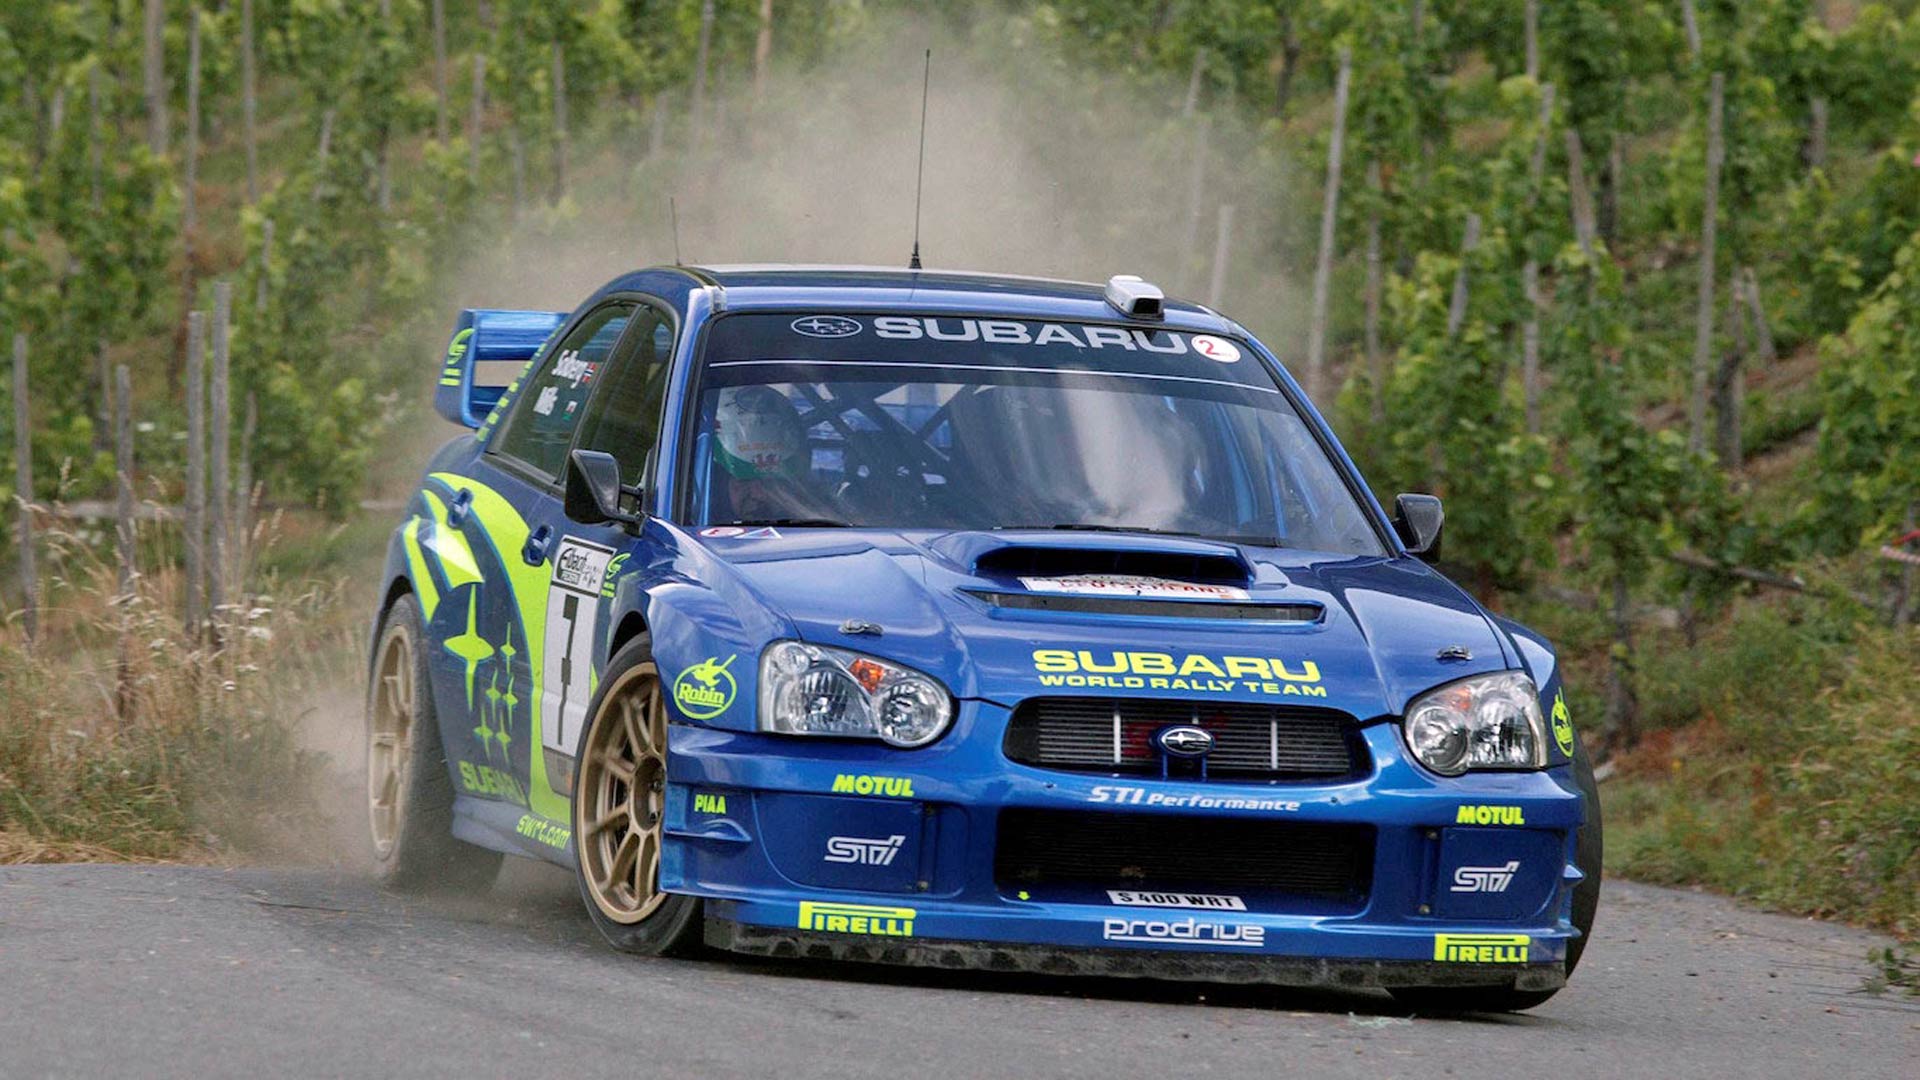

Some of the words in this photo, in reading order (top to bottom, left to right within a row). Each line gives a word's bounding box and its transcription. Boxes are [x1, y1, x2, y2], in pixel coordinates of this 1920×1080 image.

[873, 317, 1188, 355] SUBARU
[1032, 650, 1321, 683] SUBARU
[679, 682, 726, 707] Robin
[1038, 675, 1144, 688] WORLD
[1150, 676, 1235, 692] RALLY
[1243, 681, 1328, 697] TEAM
[831, 774, 915, 797] MOTUL
[694, 794, 727, 814] PIAA
[1087, 786, 1146, 804] STI
[1146, 793, 1301, 811] Performance
[1456, 806, 1525, 825] MOTUL
[516, 814, 572, 850] swrt.com
[1118, 892, 1134, 902] S
[1139, 892, 1180, 905] 400
[1184, 895, 1234, 907] WRT
[798, 901, 917, 937] PIRELLI
[1103, 918, 1266, 947] prodrive
[1433, 933, 1531, 963] PIRELLI
